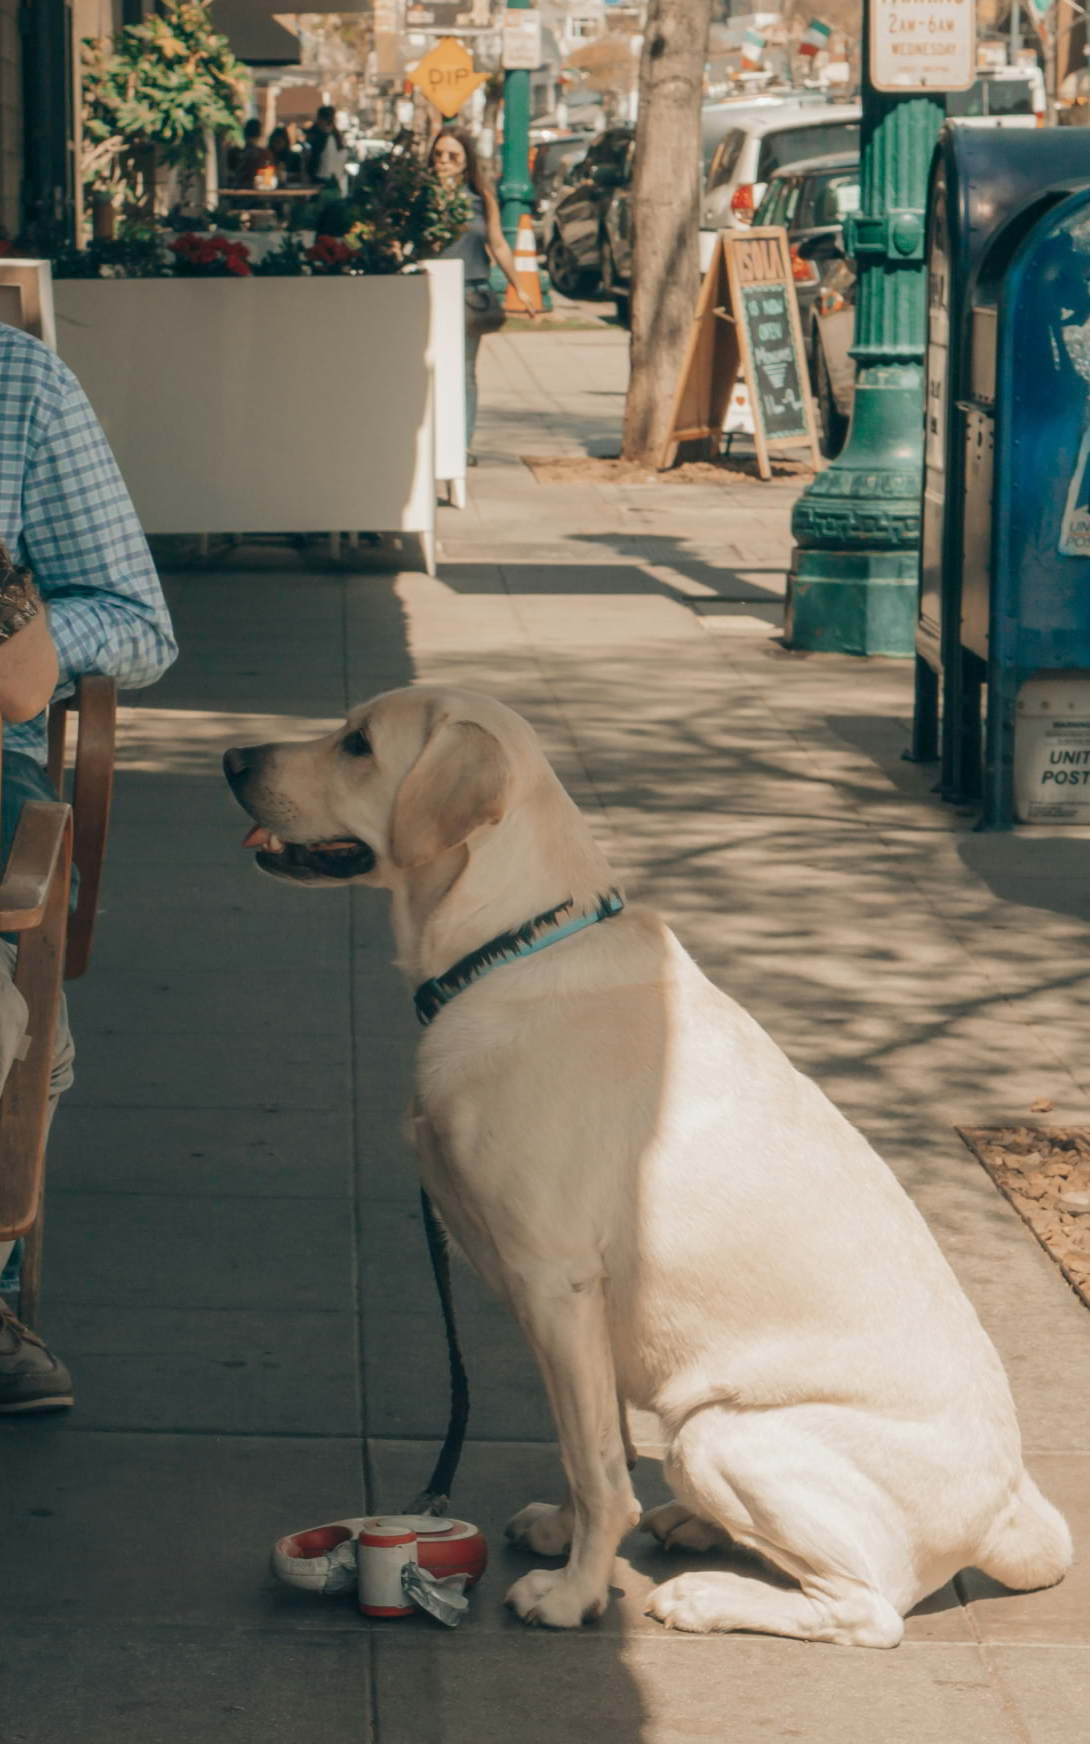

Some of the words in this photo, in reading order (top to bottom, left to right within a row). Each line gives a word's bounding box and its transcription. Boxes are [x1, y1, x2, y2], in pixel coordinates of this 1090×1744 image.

[891, 43, 958, 56] WEDNESDAY
[429, 68, 469, 85] DIP
[1050, 751, 1090, 765] UNIT
[1041, 770, 1090, 785] POST
